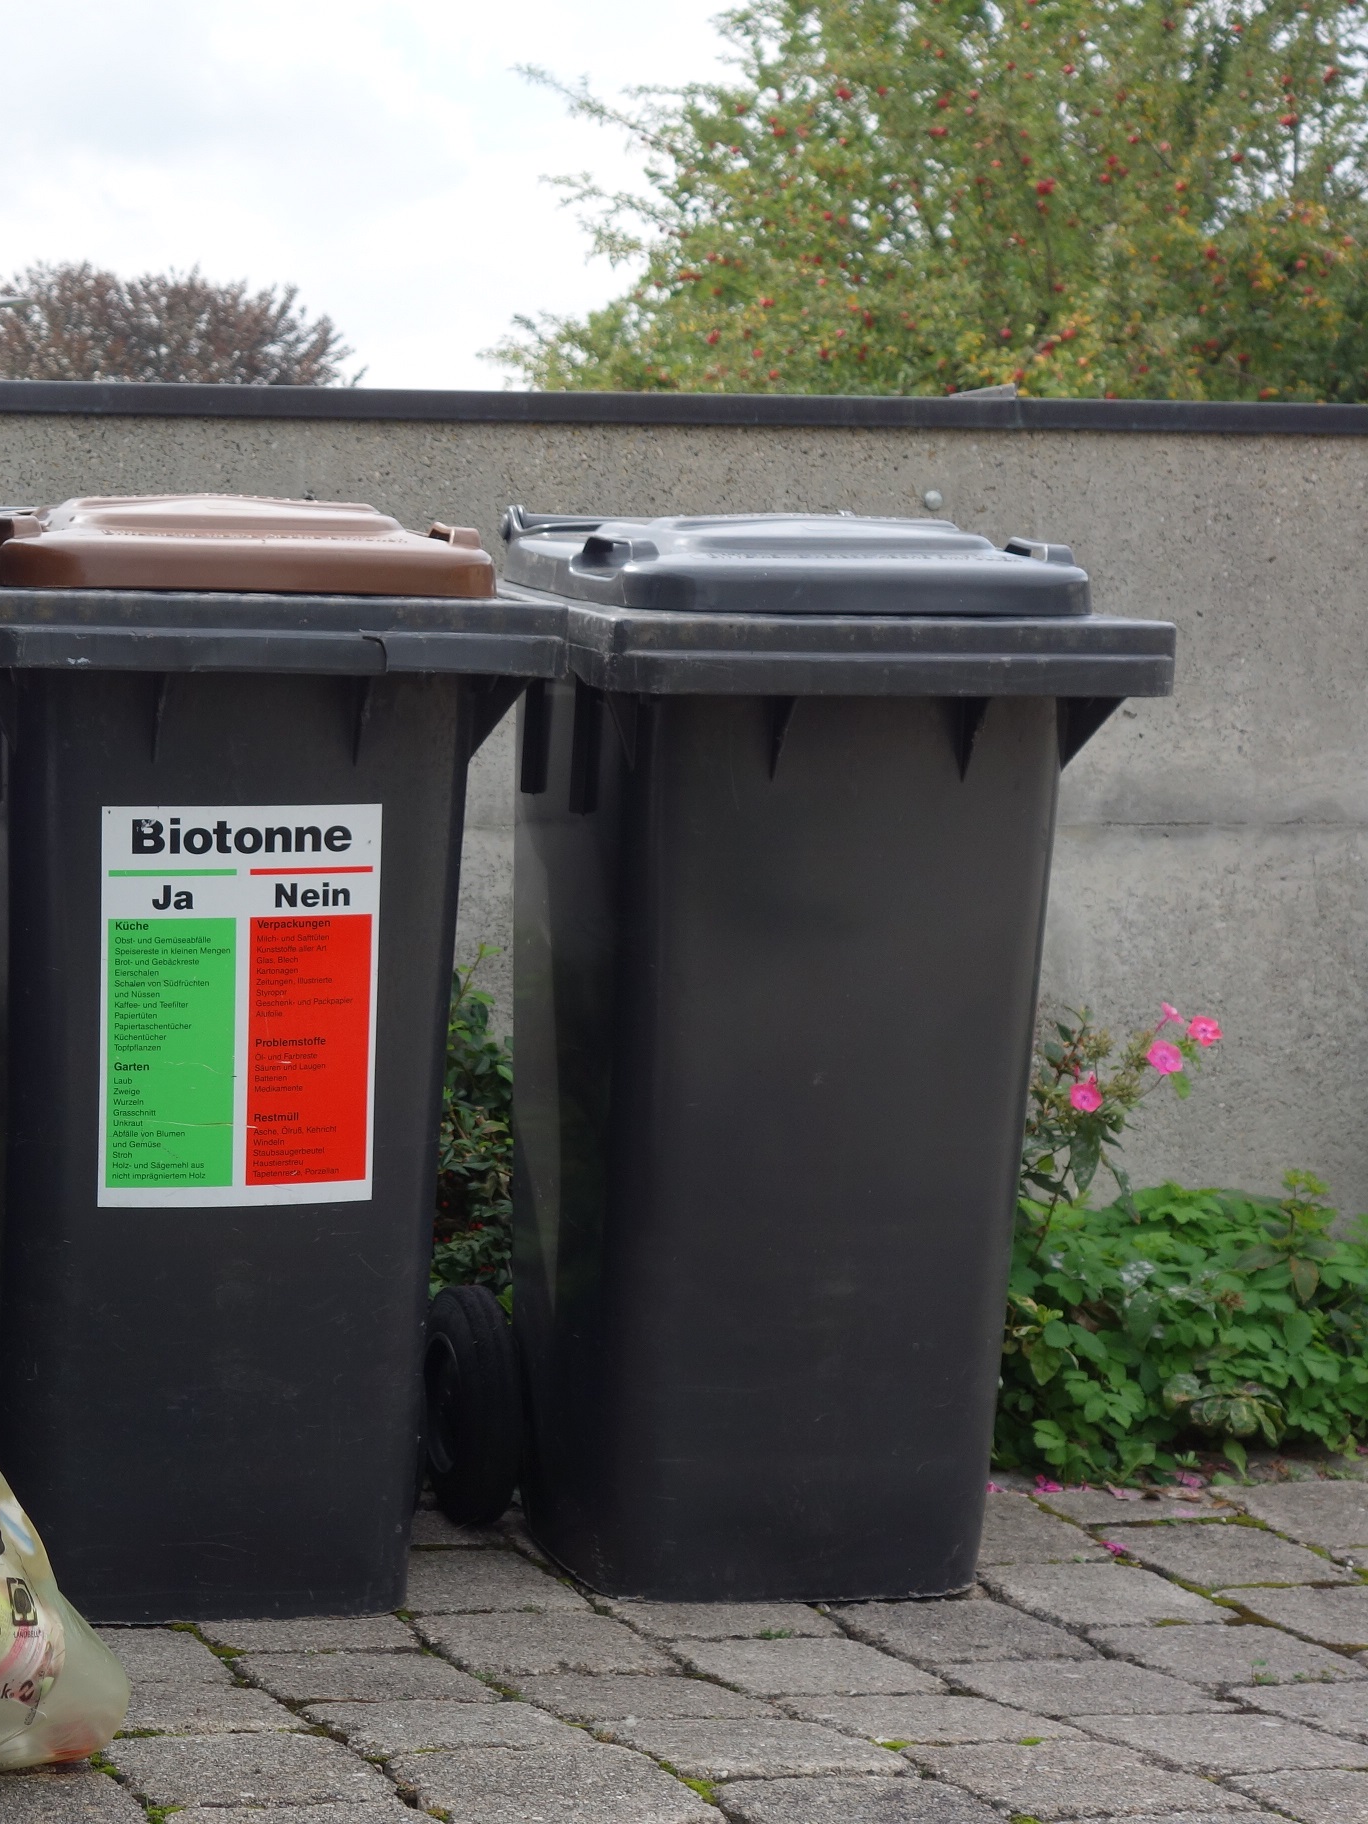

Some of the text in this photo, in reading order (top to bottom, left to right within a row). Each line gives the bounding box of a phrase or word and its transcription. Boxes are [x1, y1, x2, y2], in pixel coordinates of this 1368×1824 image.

[132, 818, 352, 855] Biotonne
[152, 885, 194, 910] Ja
[275, 882, 351, 908] Nein
[115, 921, 149, 931] Küche
[257, 920, 331, 931] Verpackungen
[114, 936, 212, 944] Obst- Gemüseabfälle
[297, 934, 330, 942] Safttüten
[114, 947, 231, 956] Speisereste kleinen Mengen
[256, 945, 297, 954] Kunststoffe
[114, 958, 133, 966] Brot-
[114, 969, 159, 977] Eierschalen
[256, 967, 299, 975] Kartonagen
[114, 979, 210, 988] Schalen Südfrüchten
[256, 978, 296, 987] Zeitungen,
[131, 990, 160, 998] Nüssen
[256, 989, 287, 997] Styropor
[114, 1001, 189, 1009] Kaffee- Teefilter
[256, 997, 353, 1007] Geschenk- Packpapier
[114, 1012, 157, 1021] Papiertüten
[256, 1010, 283, 1018] Alufolie
[114, 1022, 192, 1031] Papiertaschentücher
[114, 1033, 167, 1041] Küchentücher
[255, 1037, 326, 1047] Problemstoffe
[114, 1044, 161, 1052] Topfpflanzen
[114, 1062, 150, 1071] Garten
[113, 1077, 132, 1085] Laub
[113, 1088, 140, 1096] Zweige
[113, 1098, 144, 1106] Wurzeln
[254, 1112, 299, 1122] Restmüll
[112, 1130, 138, 1138] Abfälle
[129, 1140, 161, 1148] Gemüse
[112, 1151, 132, 1159] Stroh
[253, 1147, 325, 1157] Staubsaugerbeutel
[150, 1161, 189, 1170] Sägemehl
[253, 1159, 304, 1167] Haustierstreu
[132, 1172, 187, 1181] imprägniertem
[189, 1171, 206, 1179] Holz
[253, 1170, 303, 1178] Tapetenreste,
